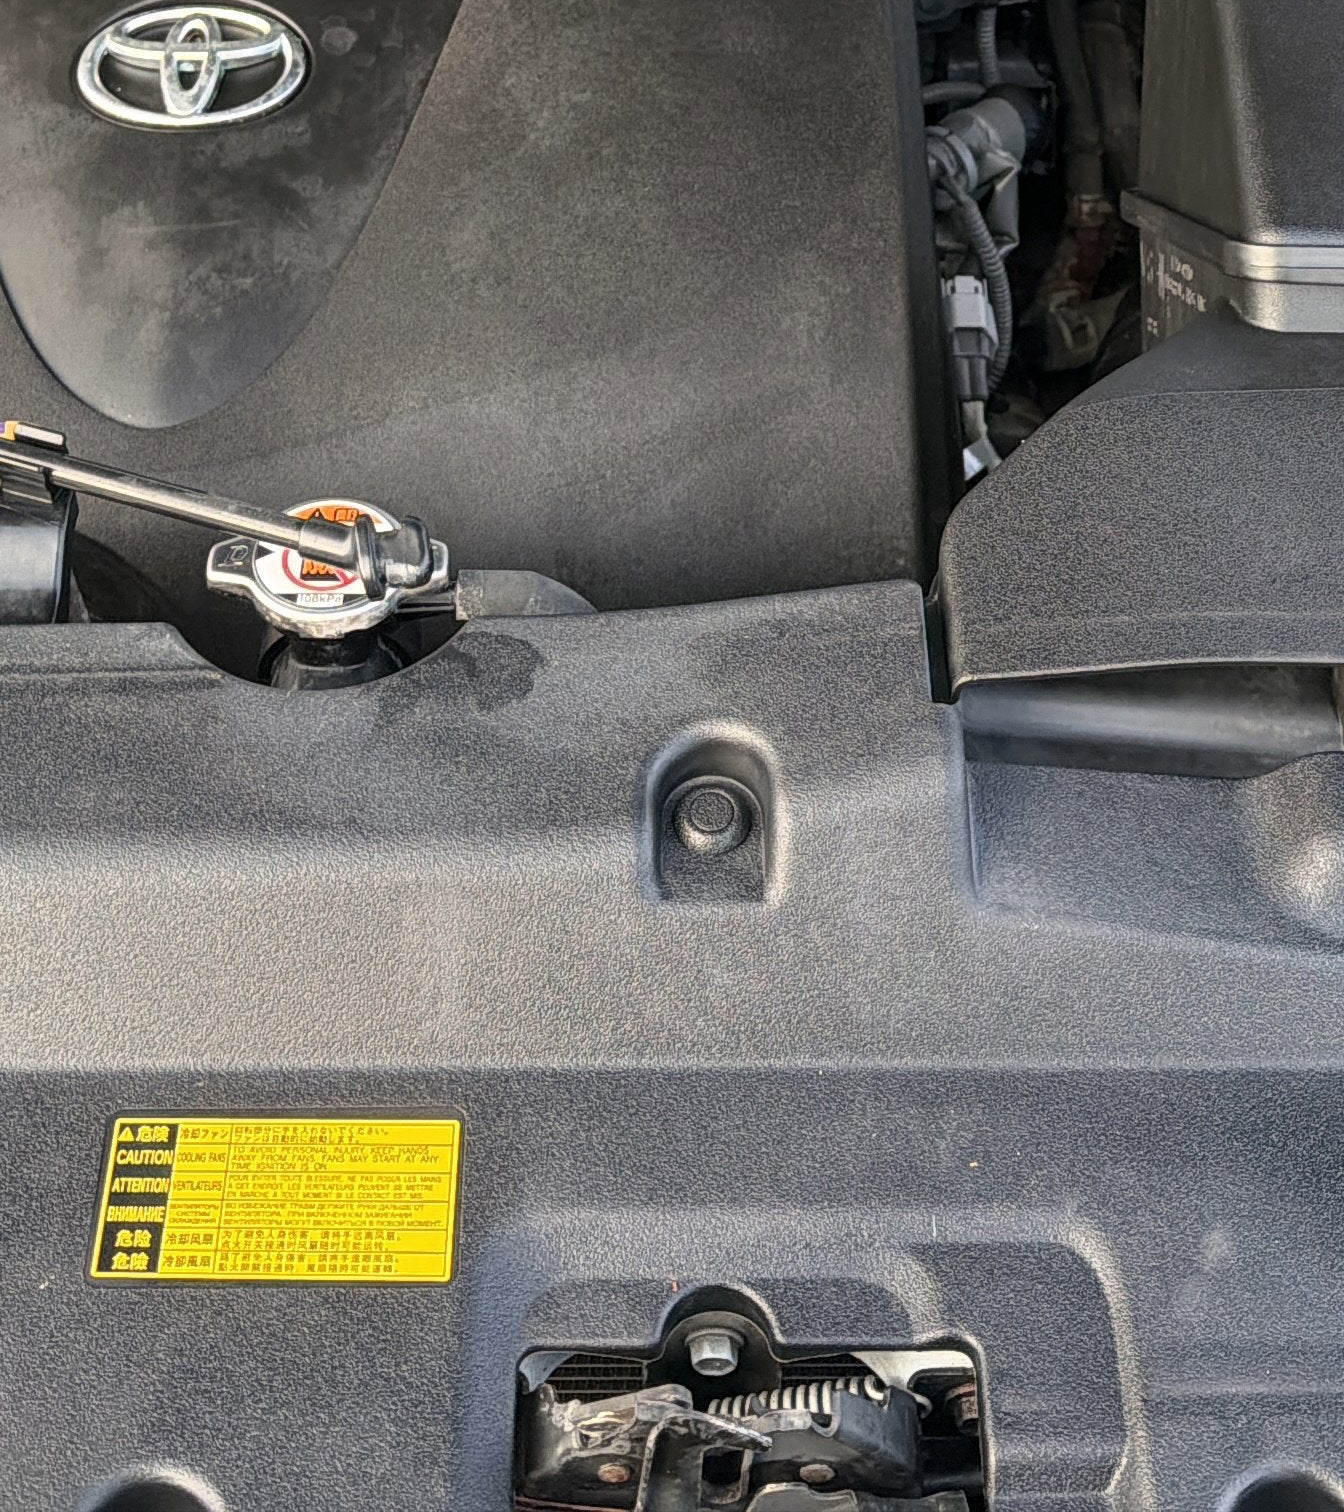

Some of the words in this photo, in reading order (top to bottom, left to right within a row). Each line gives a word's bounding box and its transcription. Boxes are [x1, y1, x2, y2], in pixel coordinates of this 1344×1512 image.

[136, 1125, 170, 1142] 危険
[116, 1149, 174, 1165] CAUTION
[177, 1152, 206, 1163] COOLING
[111, 1177, 170, 1193] ATTENTION
[106, 1205, 166, 1222] ВНИМАНИЕ
[115, 1229, 152, 1247] 危险
[111, 1252, 150, 1270] 危險
